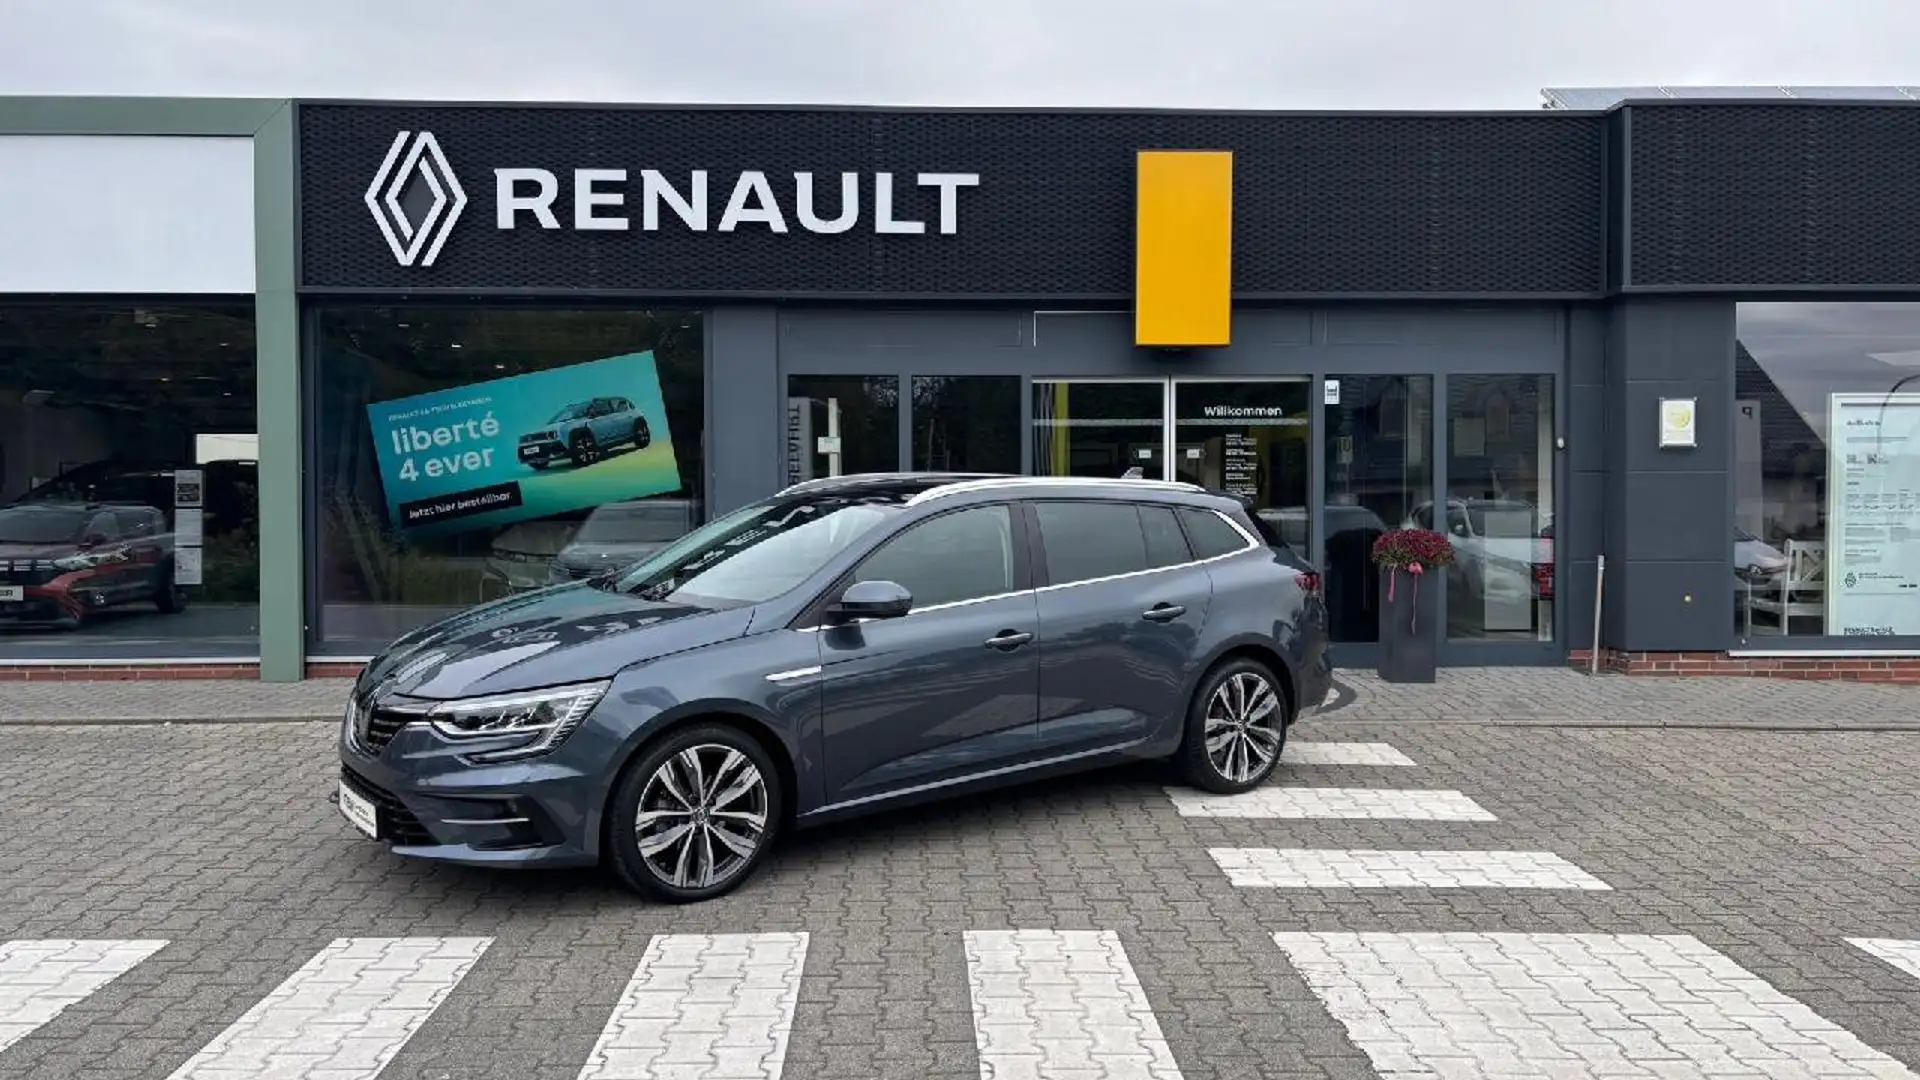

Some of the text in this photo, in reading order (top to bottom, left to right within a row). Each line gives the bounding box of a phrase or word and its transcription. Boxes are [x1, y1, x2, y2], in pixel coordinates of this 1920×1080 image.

[494, 168, 980, 235] RENAULT
[1204, 405, 1282, 417] Willkommen
[391, 411, 500, 455] liberté
[399, 447, 495, 482] 4 ever
[435, 503, 456, 515] hier
